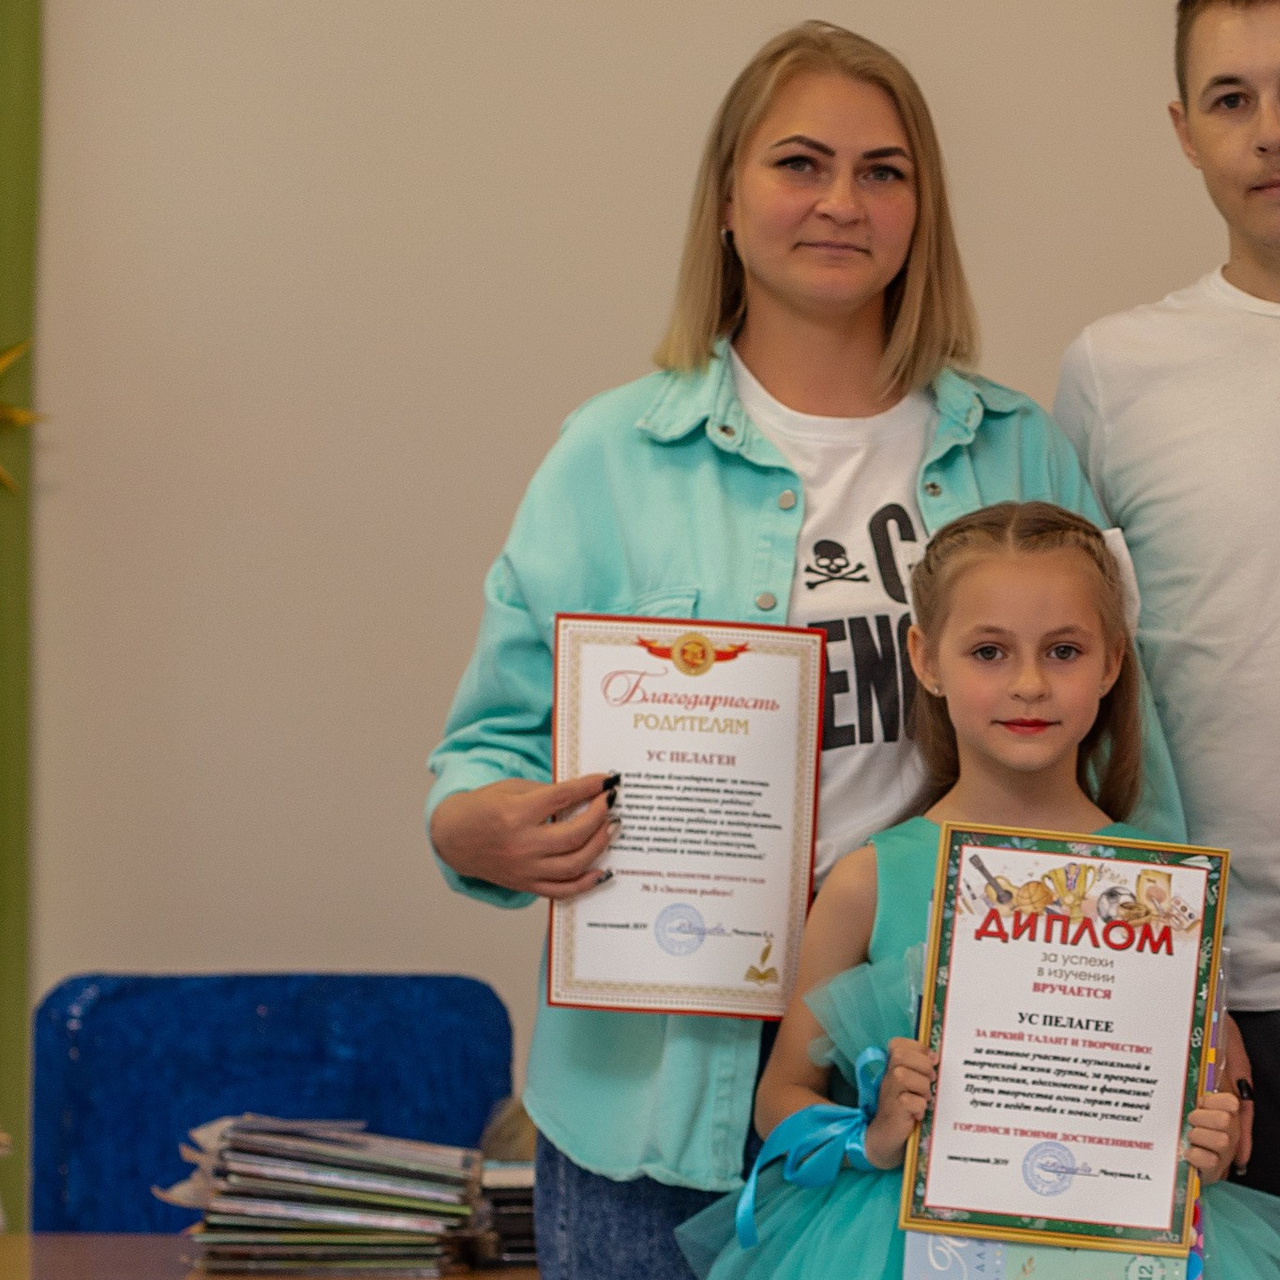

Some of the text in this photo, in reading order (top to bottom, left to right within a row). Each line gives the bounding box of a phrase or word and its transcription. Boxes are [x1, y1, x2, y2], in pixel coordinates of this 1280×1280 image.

[601, 666, 779, 712] Благодарность
[633, 713, 749, 735] РОДИТЕЛЯМ
[974, 908, 1173, 955] ДИПЛОМ
[1041, 952, 1114, 968] за успехи
[1037, 967, 1115, 983] в изучении
[1032, 982, 1112, 999] ВРУЧАЕТСЯ
[1018, 1012, 1114, 1033] УС ПЕЛАГЕЕ
[975, 1029, 987, 1038] ЗА
[990, 1030, 1024, 1041] ЯРКИЙ
[1028, 1034, 1068, 1046] ТАЛАНТ
[953, 1122, 1011, 1136] ГОРДИМСЯ
[1138, 1265, 1154, 1280] 12
